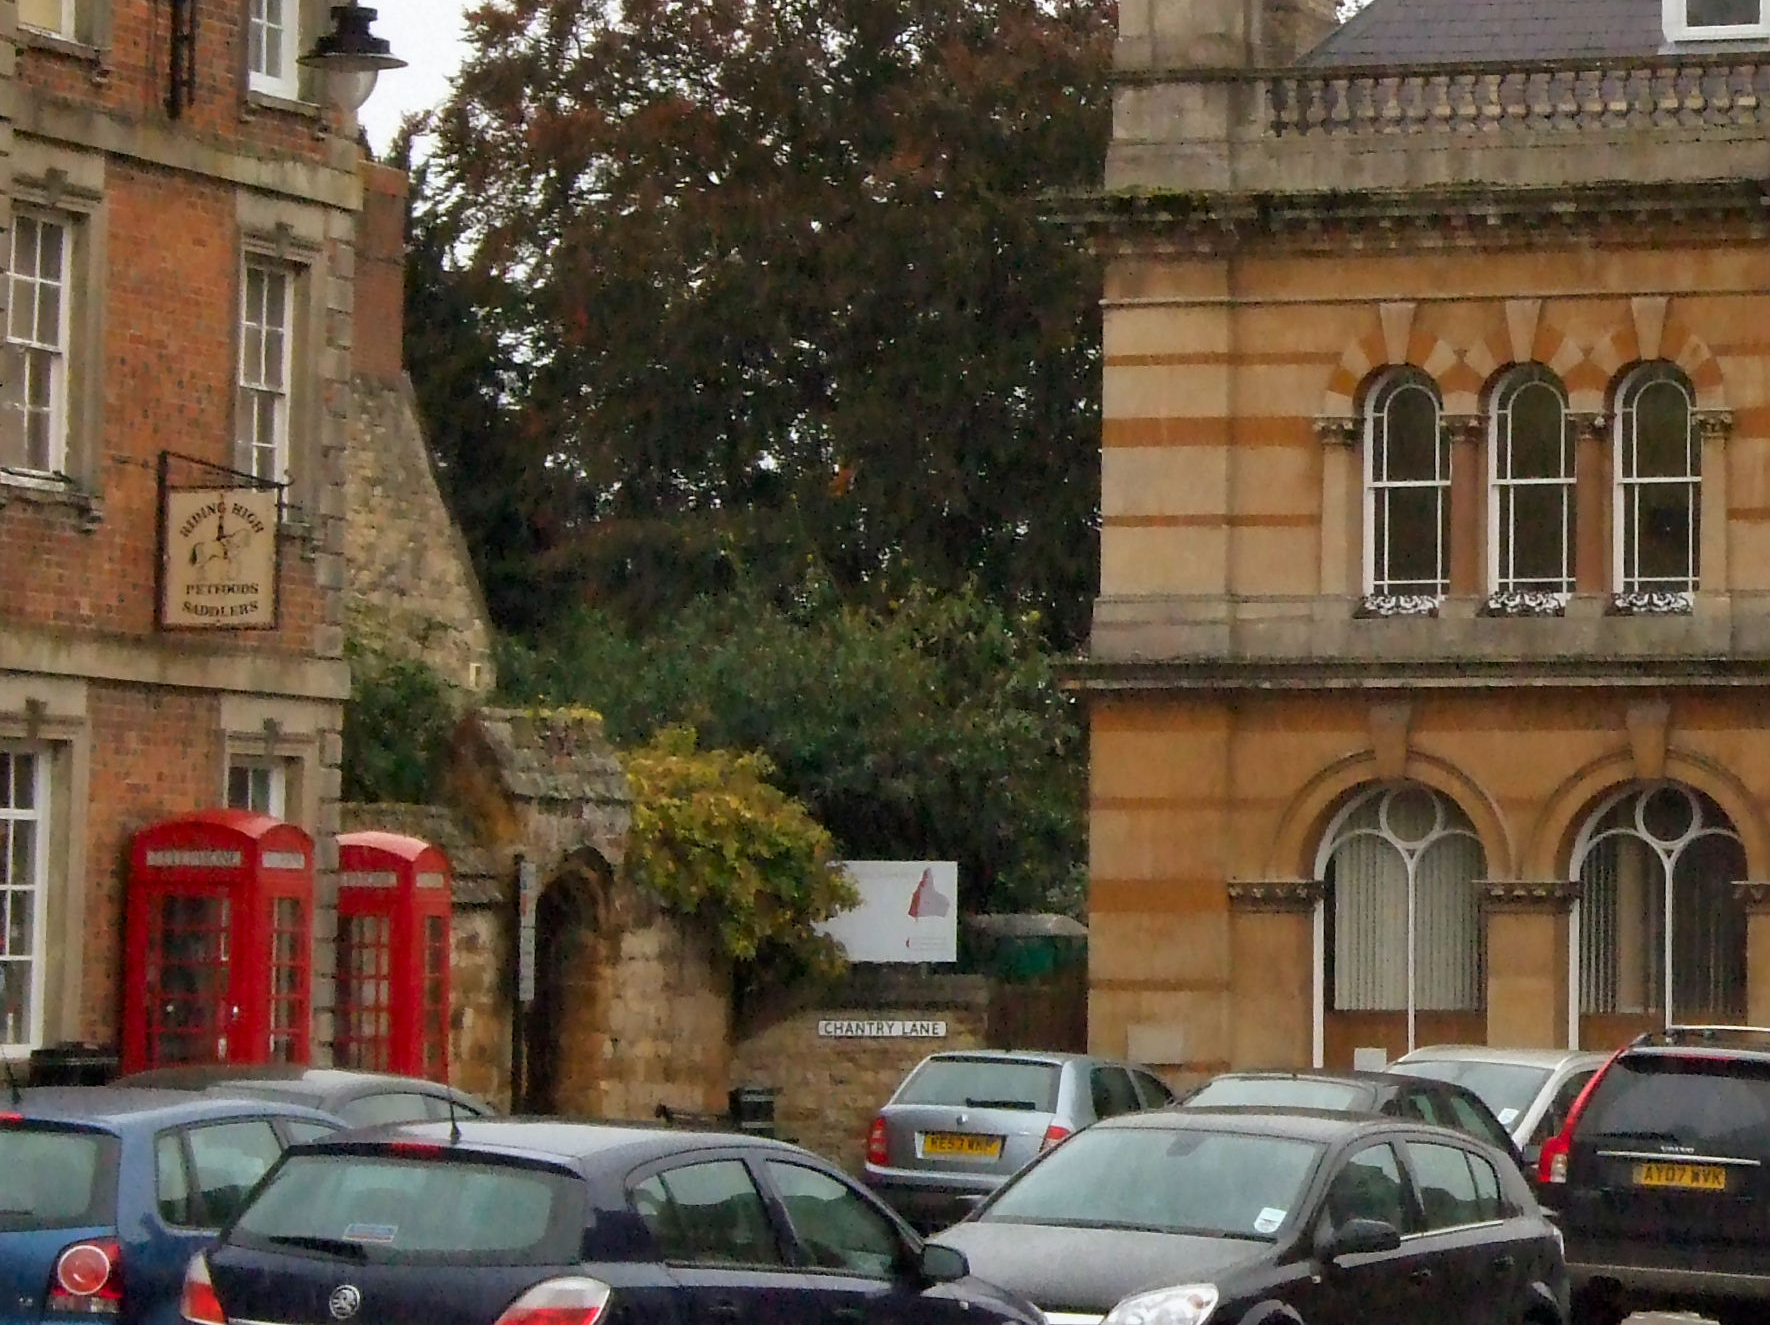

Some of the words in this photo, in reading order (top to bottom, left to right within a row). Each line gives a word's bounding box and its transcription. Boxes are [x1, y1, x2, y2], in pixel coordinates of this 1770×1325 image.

[180, 502, 227, 538] RIDING
[231, 502, 265, 534] HIGH
[182, 600, 259, 617] SADDLERS
[824, 1022, 895, 1035] CHANTRY
[901, 1022, 939, 1035] LANE
[1643, 1164, 1687, 1182] AY07
